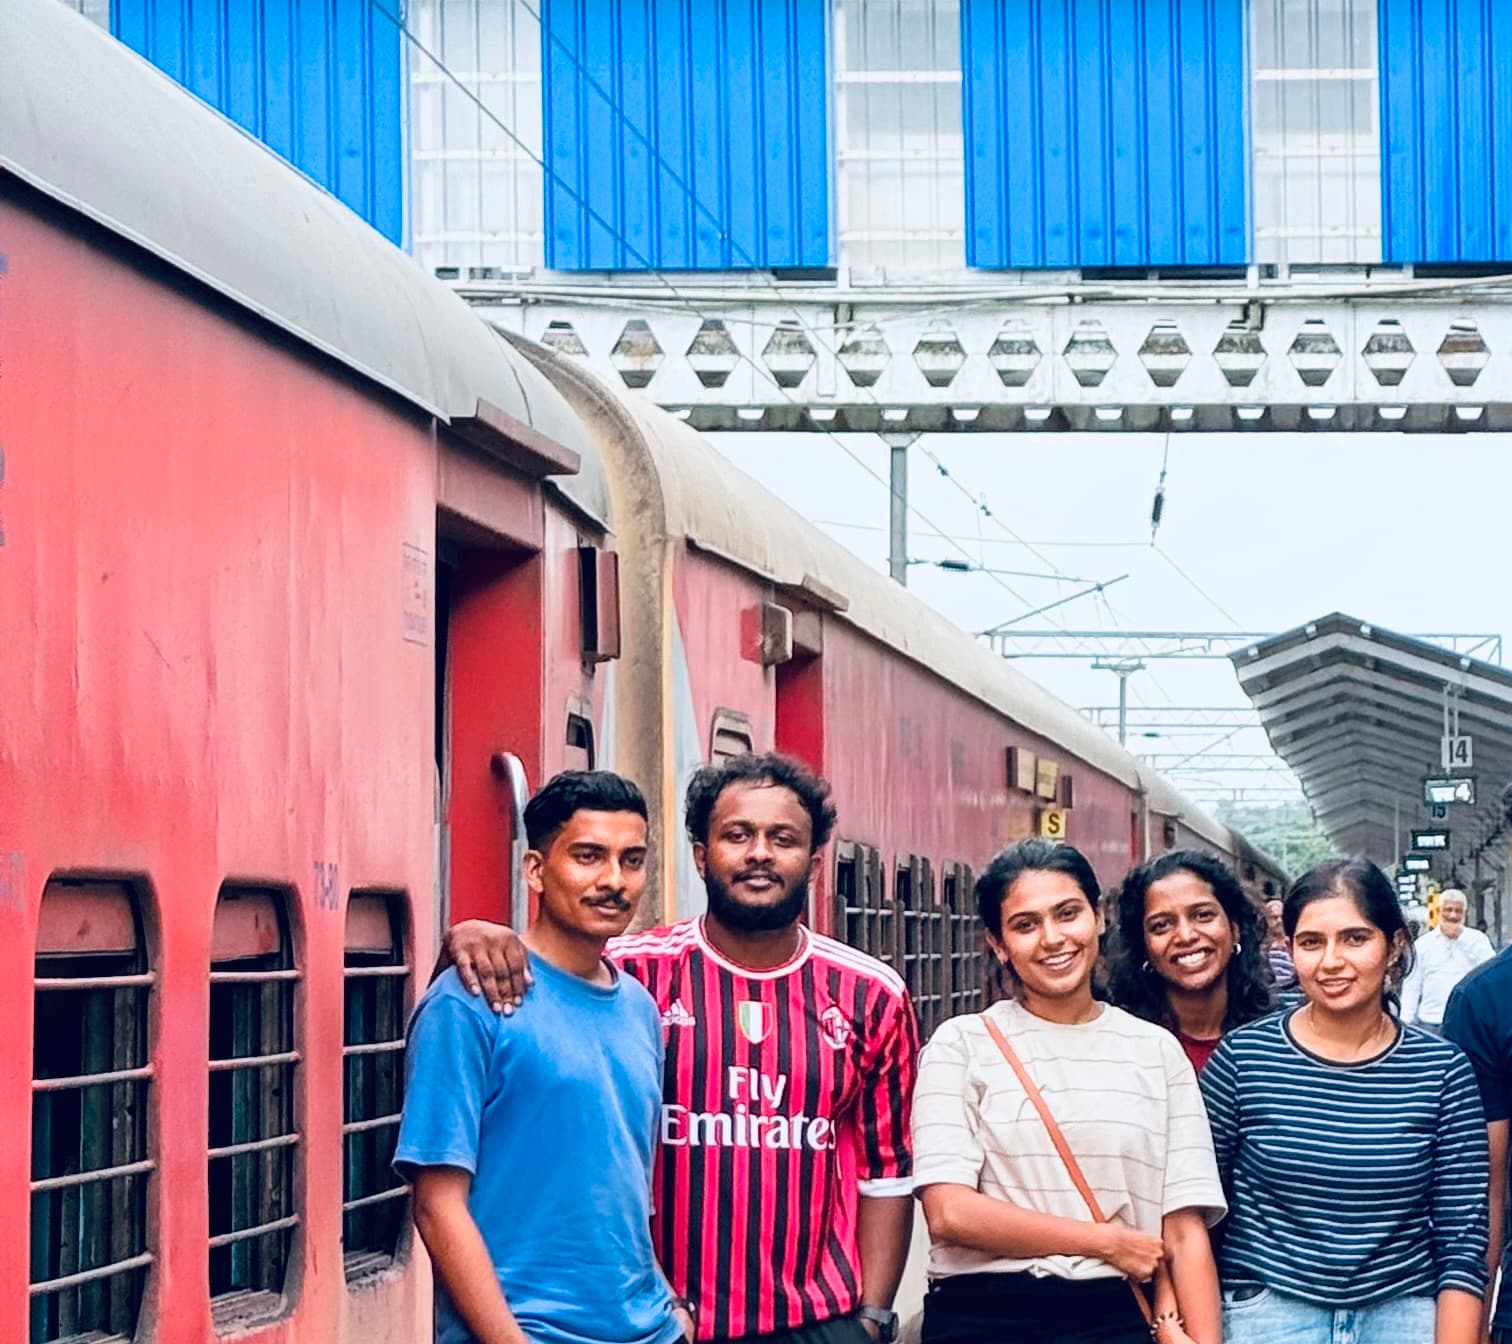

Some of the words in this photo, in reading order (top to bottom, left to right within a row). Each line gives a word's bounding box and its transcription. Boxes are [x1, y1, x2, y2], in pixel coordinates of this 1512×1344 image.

[1447, 738, 1468, 764] 14
[1047, 811, 1061, 835] S
[727, 1064, 788, 1109] Fly
